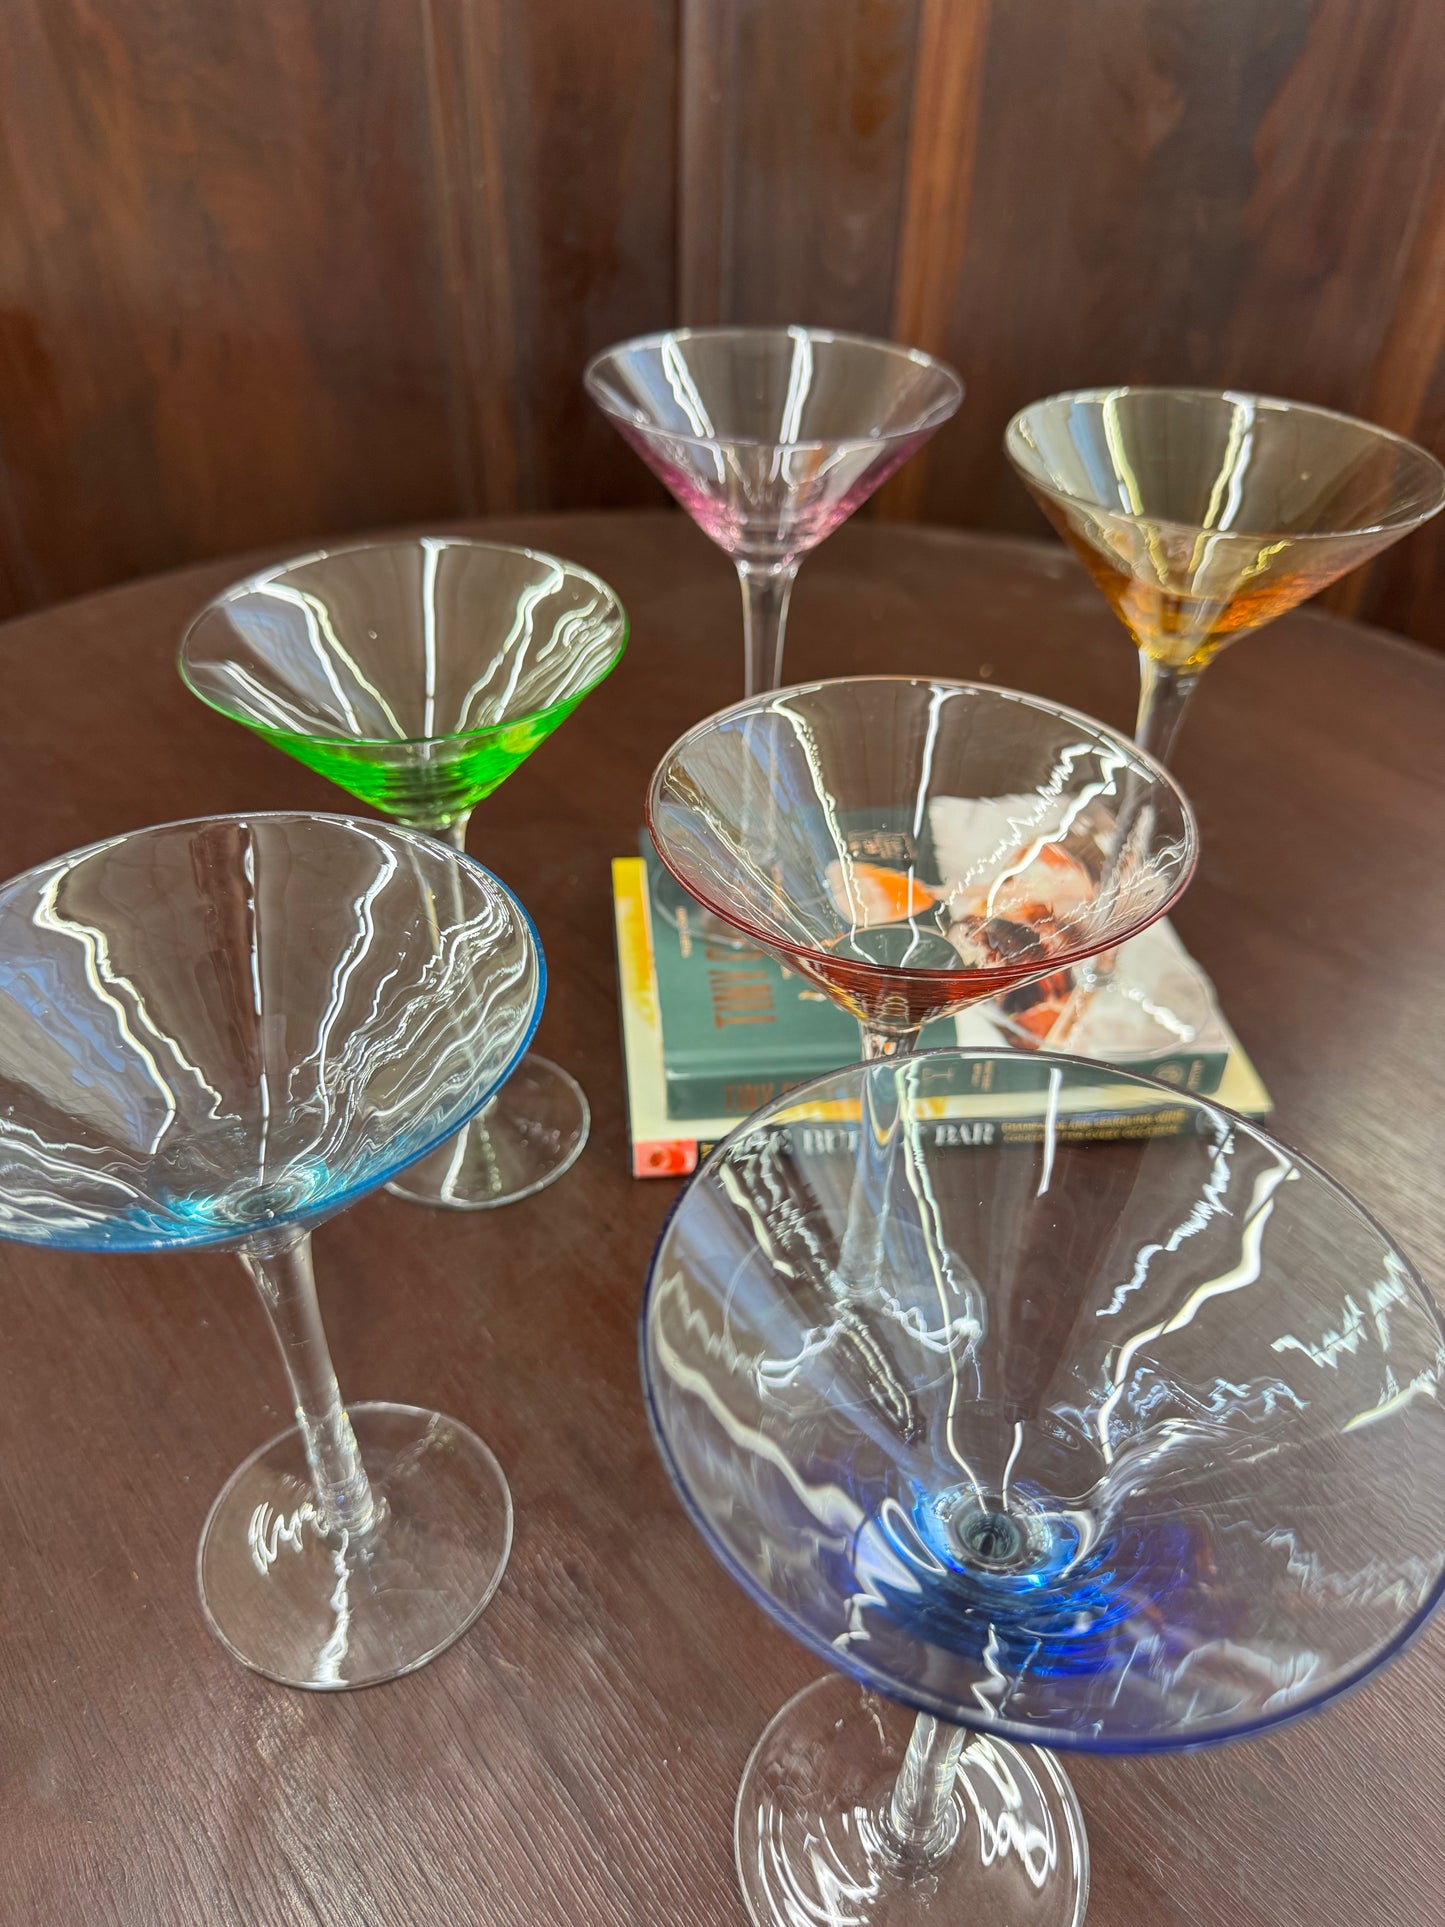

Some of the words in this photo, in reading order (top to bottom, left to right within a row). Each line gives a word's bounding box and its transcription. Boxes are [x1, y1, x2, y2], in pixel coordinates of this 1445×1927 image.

[709, 969, 776, 1029] TINY
[722, 1080, 776, 1114] TINY
[935, 1121, 996, 1147] BAR
